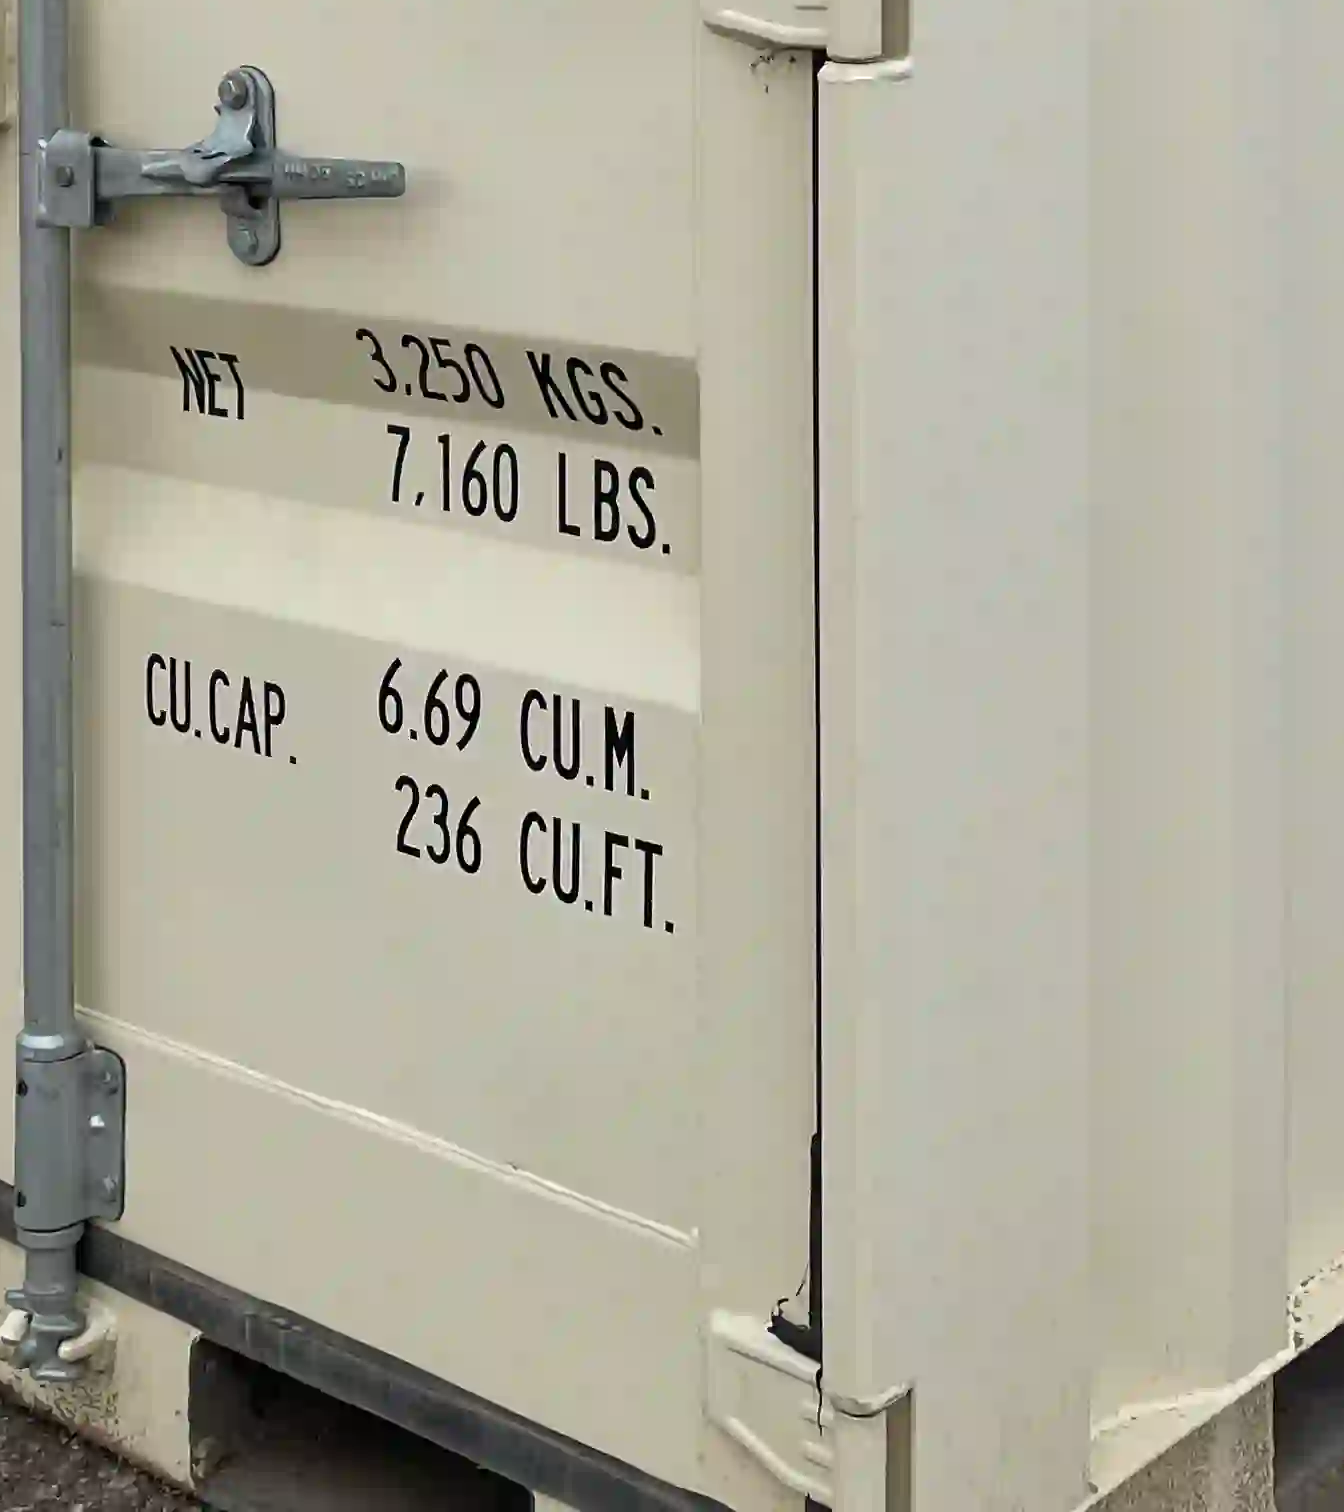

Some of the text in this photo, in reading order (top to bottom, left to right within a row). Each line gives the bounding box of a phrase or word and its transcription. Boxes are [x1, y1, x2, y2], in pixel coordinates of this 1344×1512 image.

[169, 345, 247, 420] NET
[525, 350, 663, 436] KGS.
[387, 424, 671, 555] 7,160 LBS.
[146, 653, 297, 765] CU.CAP.
[378, 657, 650, 801] 6.69 CU.M.
[395, 775, 675, 934] 236 CU.FT.
